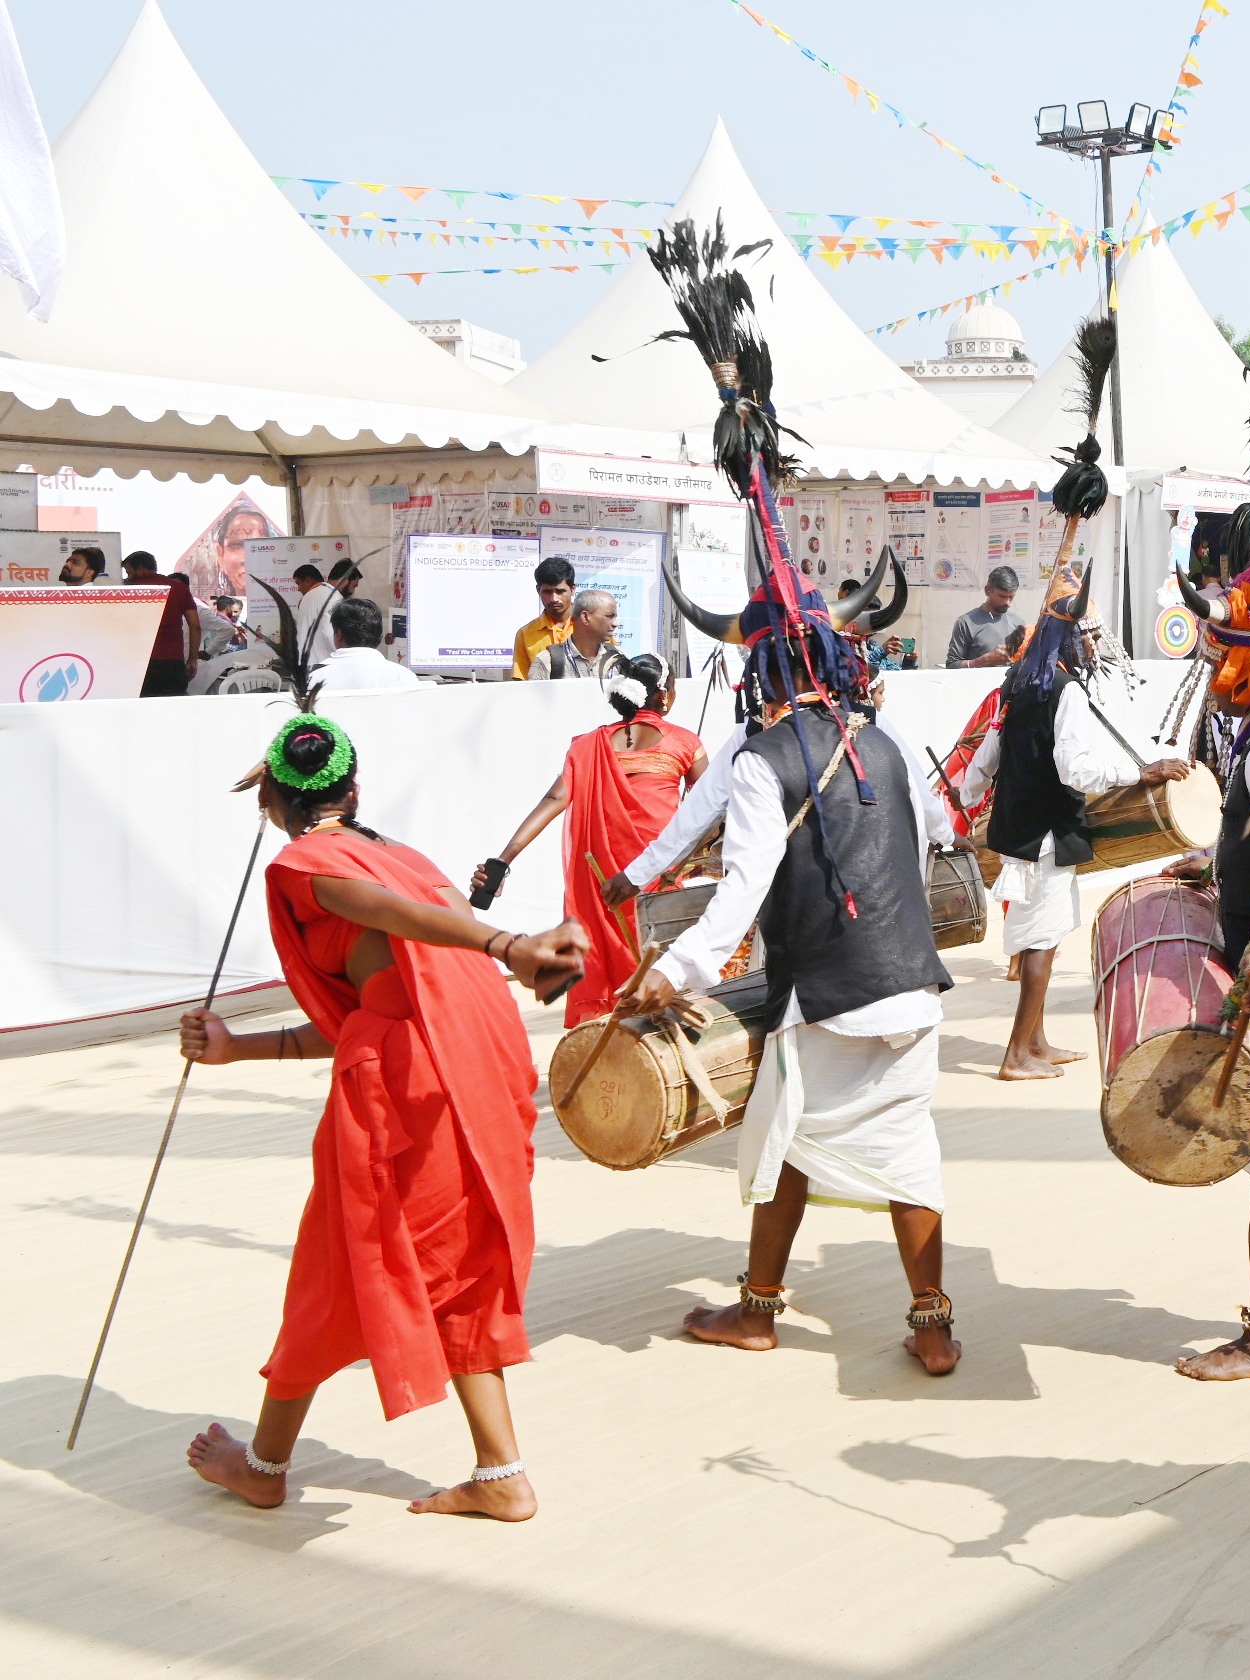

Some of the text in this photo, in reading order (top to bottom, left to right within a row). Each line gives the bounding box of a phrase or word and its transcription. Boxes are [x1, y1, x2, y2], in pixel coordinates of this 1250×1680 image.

[588, 467, 713, 492] पिरामल फाउंडेशन, छत्तीसगढ़
[8, 562, 50, 583] दिवस
[414, 557, 535, 568] INDIGENOUS PRIDE DAY-2024
